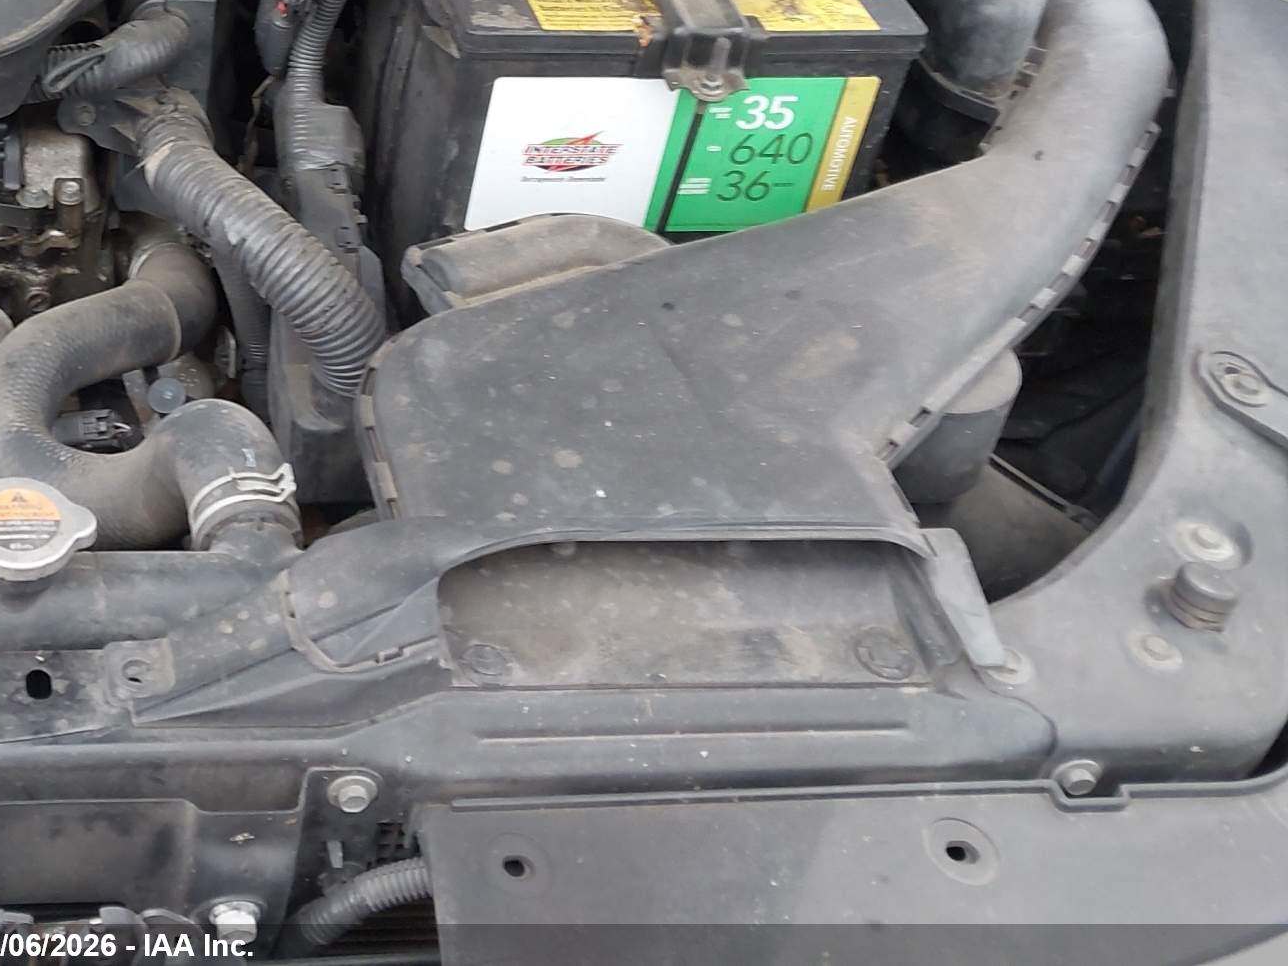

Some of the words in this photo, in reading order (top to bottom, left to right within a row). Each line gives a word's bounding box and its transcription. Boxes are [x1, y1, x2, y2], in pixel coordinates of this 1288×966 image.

[735, 94, 800, 131] 35
[523, 144, 619, 155] INTERSTATE
[524, 155, 610, 165] BATTERIES
[729, 131, 814, 166] 640
[821, 115, 859, 193] AUTOMOTIVE
